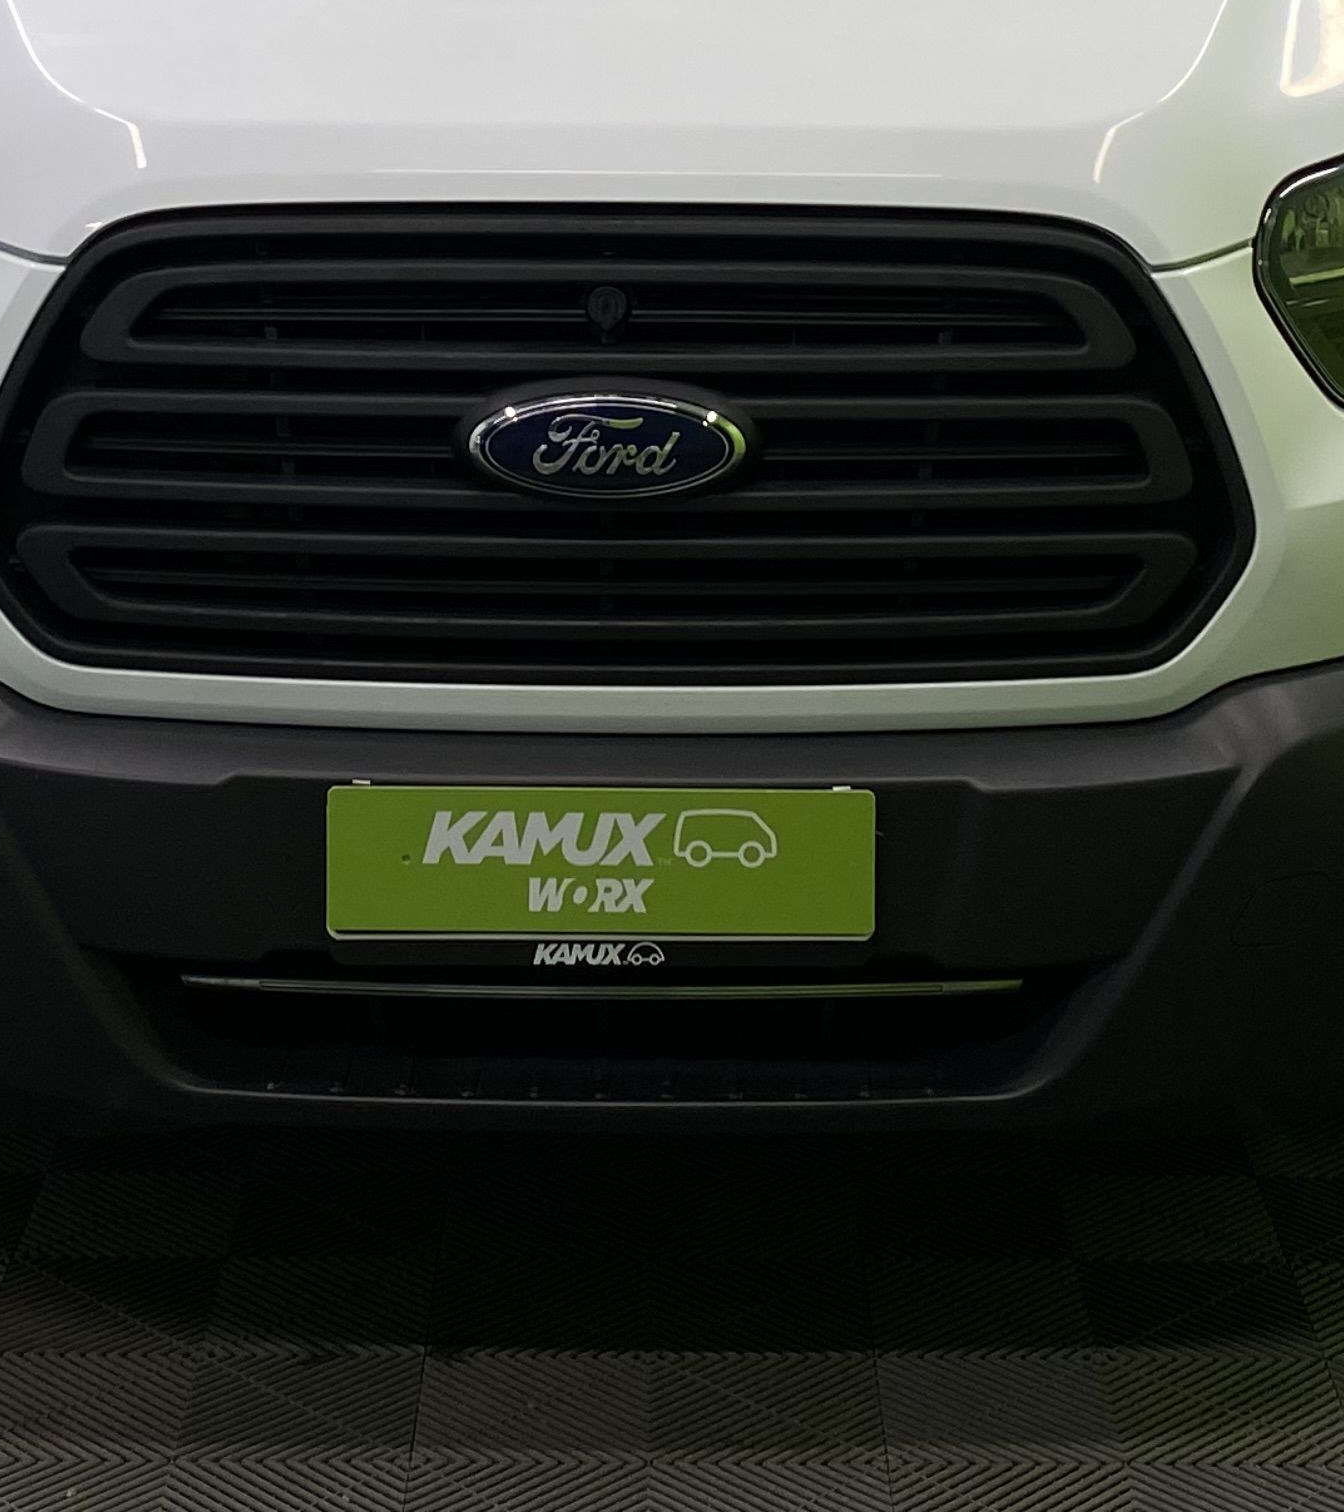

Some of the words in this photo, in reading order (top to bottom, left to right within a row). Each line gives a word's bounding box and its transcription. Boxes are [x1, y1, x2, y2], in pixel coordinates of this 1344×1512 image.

[532, 413, 681, 475] Ford
[422, 810, 667, 867] KAMUX
[528, 876, 655, 914] WORX
[533, 942, 626, 966] KAMUX
